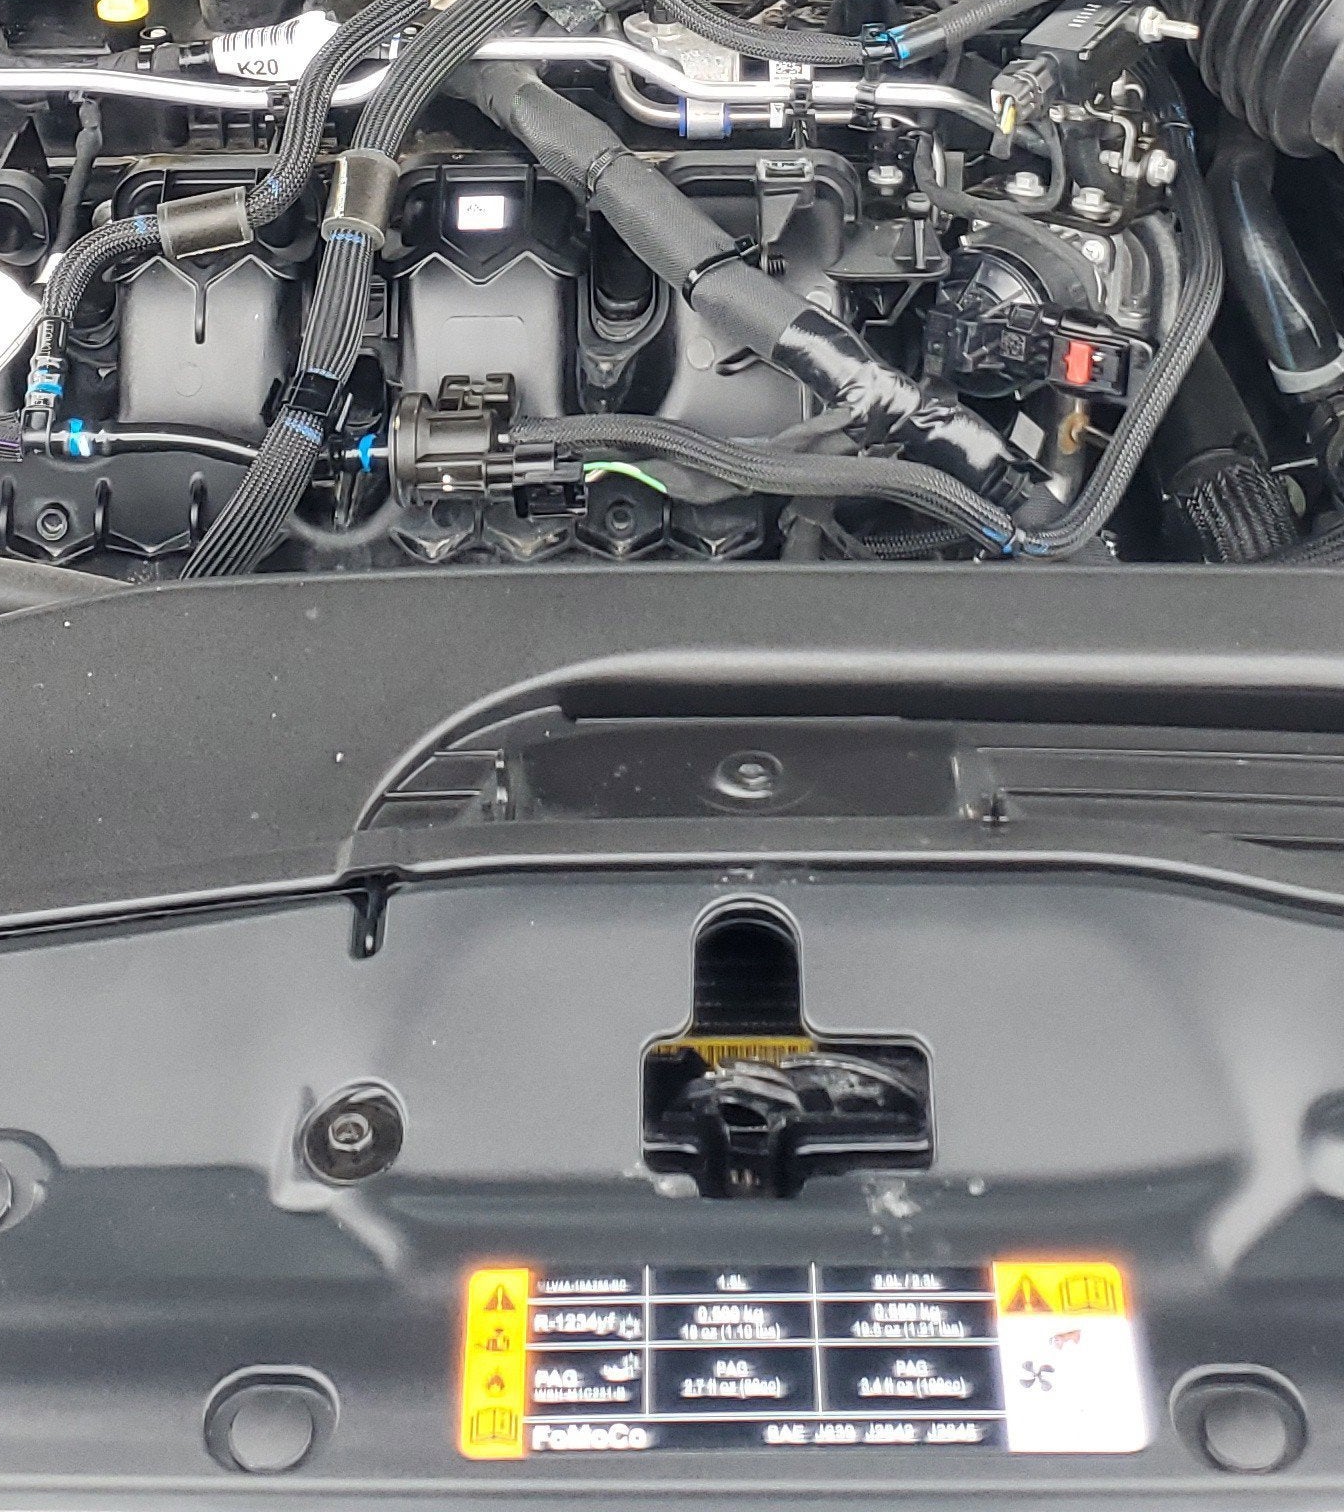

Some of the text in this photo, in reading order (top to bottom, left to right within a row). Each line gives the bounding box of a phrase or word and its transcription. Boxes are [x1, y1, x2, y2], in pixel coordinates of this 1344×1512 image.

[236, 58, 278, 79] K20
[743, 1304, 764, 1325] kg
[920, 1302, 941, 1324] kg
[534, 1311, 615, 1334] R-1234yf
[885, 1324, 901, 1337] oz
[701, 1327, 717, 1339] oz
[716, 1360, 749, 1377] PAG
[896, 1360, 928, 1377] PAG
[535, 1369, 578, 1388] PAG
[897, 1380, 913, 1395] oz
[719, 1381, 736, 1396] oz
[532, 1423, 648, 1450] FoMoCo
[767, 1424, 805, 1442] SAE
